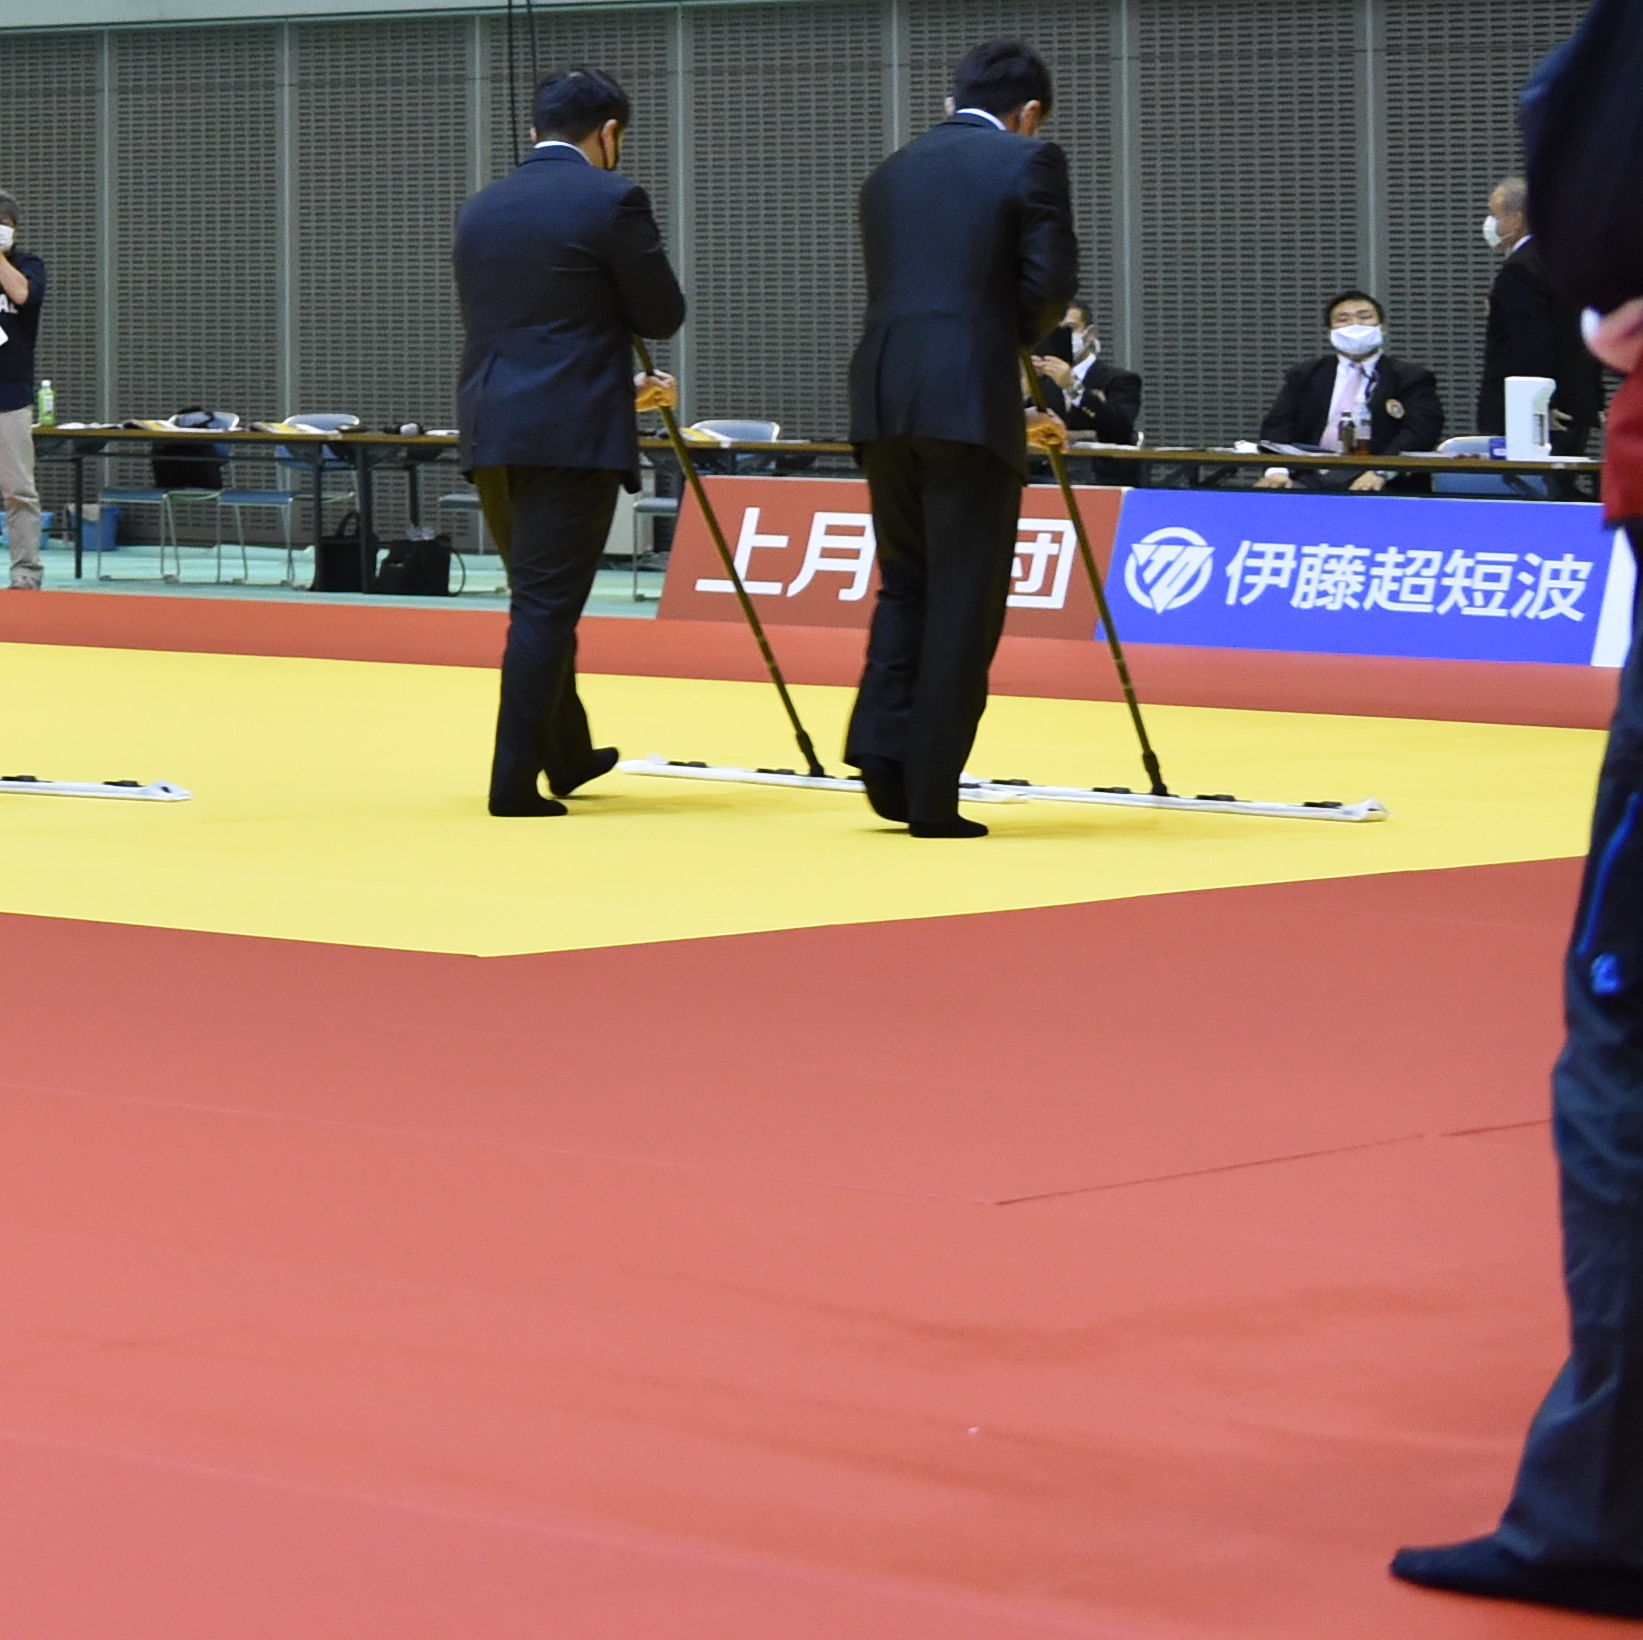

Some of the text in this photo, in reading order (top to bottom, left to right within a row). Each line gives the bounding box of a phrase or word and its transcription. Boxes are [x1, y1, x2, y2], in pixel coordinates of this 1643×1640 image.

[694, 507, 1078, 610] 上月団
[1225, 539, 1593, 622] 伊藤超短波
